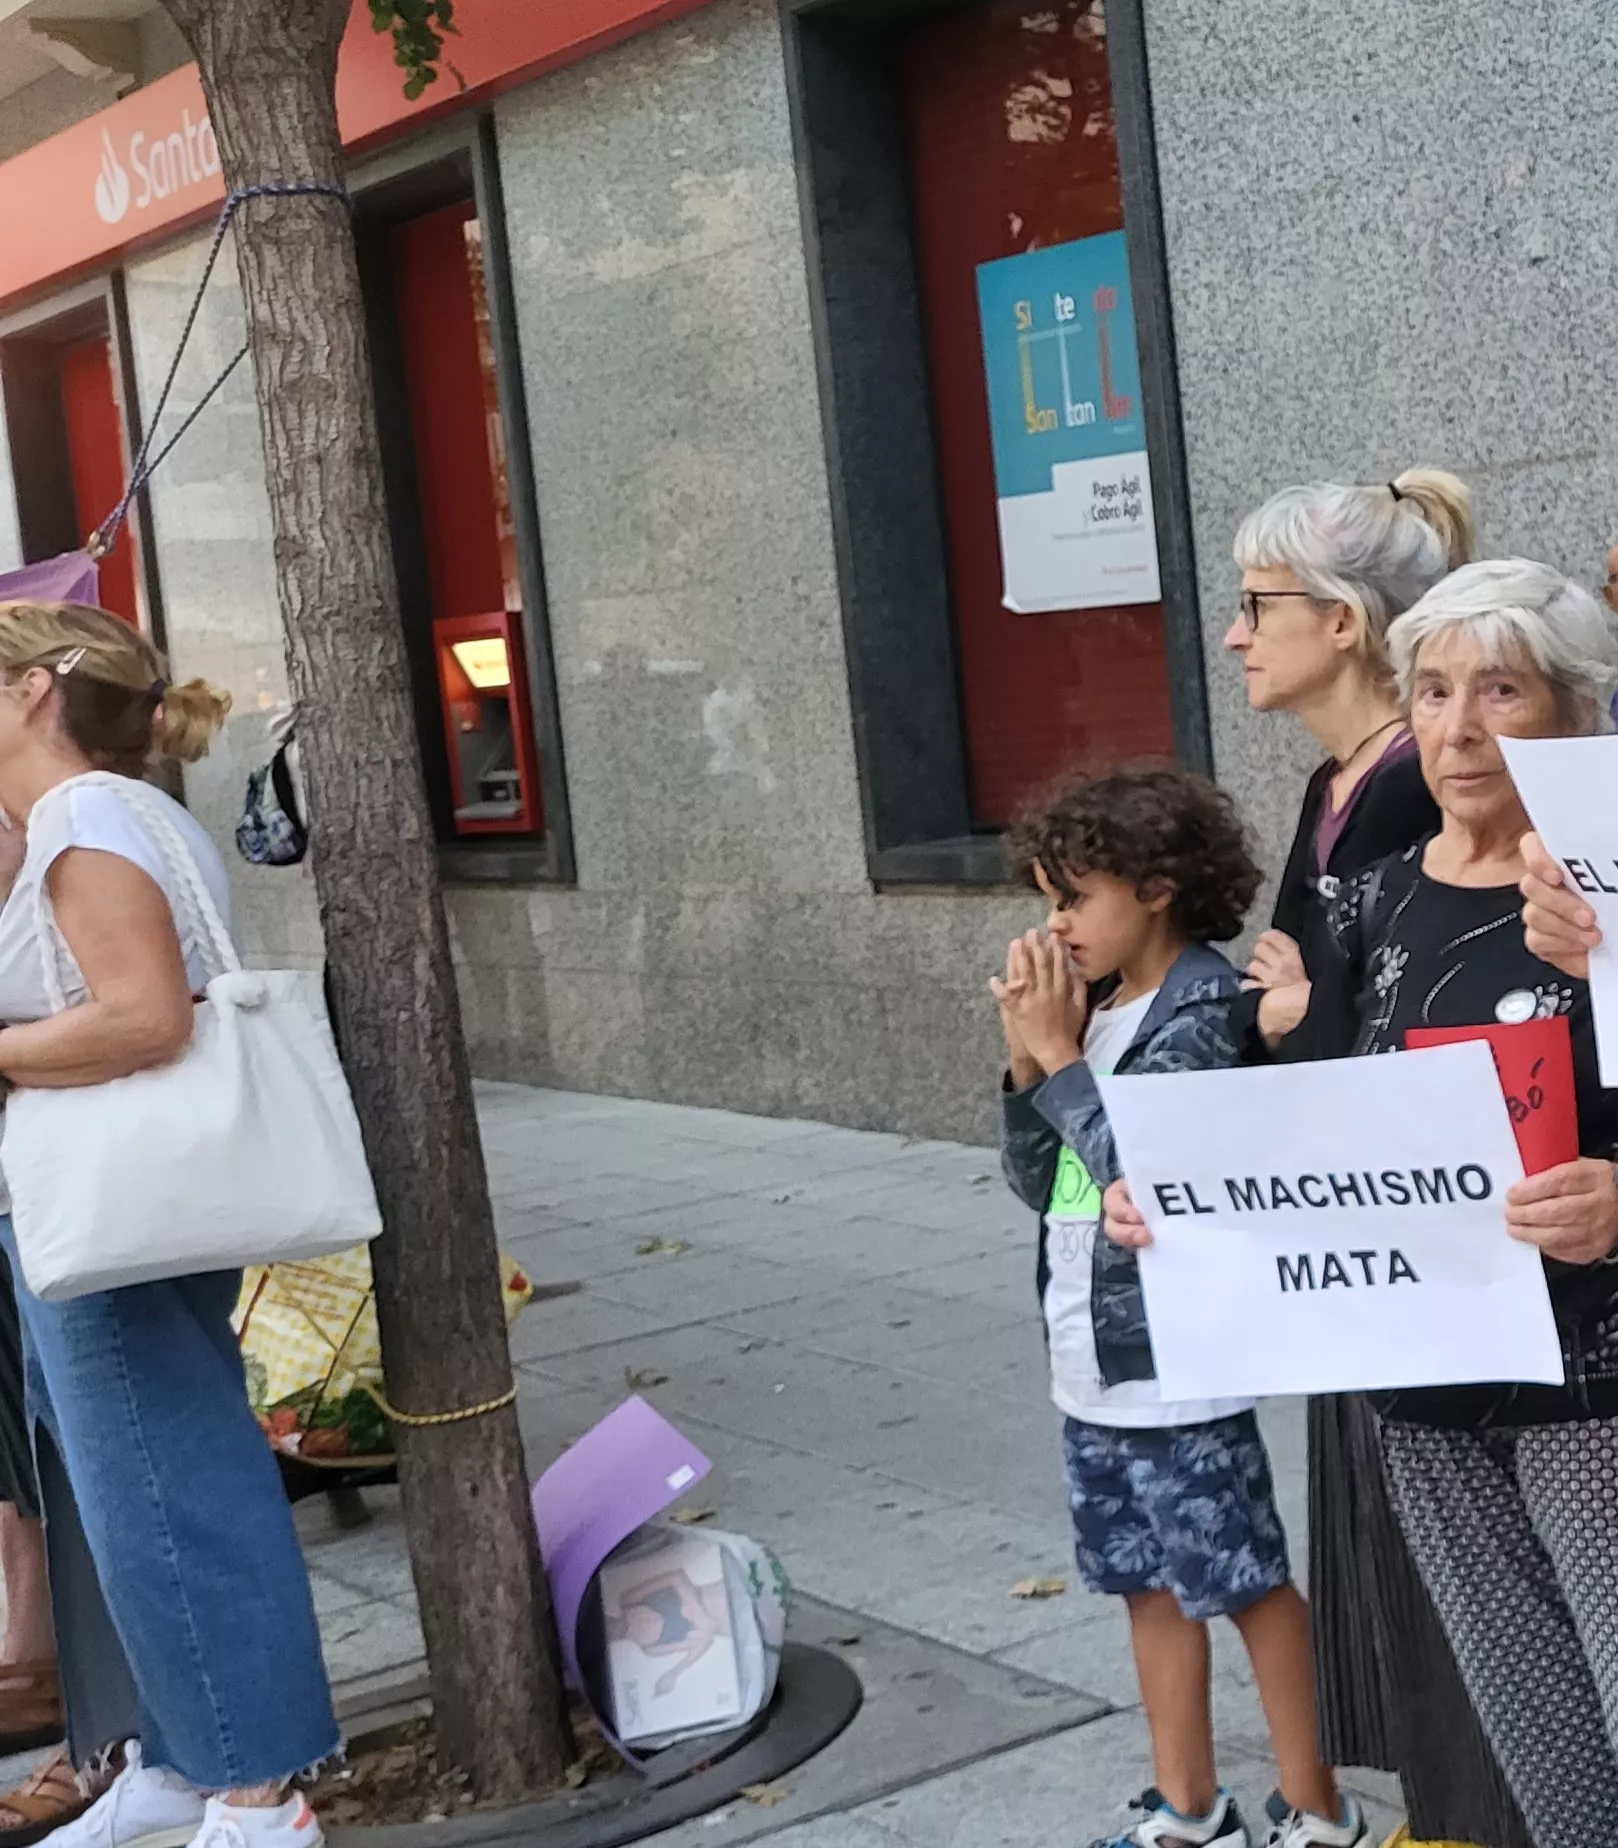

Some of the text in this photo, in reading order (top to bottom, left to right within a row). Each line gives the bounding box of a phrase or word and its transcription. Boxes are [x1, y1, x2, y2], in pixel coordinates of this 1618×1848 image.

[1092, 481, 1120, 503] Pago
[1091, 503, 1121, 522] Cobro
[1153, 1164, 1494, 1217] EL MACHISMO
[1276, 1249, 1422, 1293] MATA
